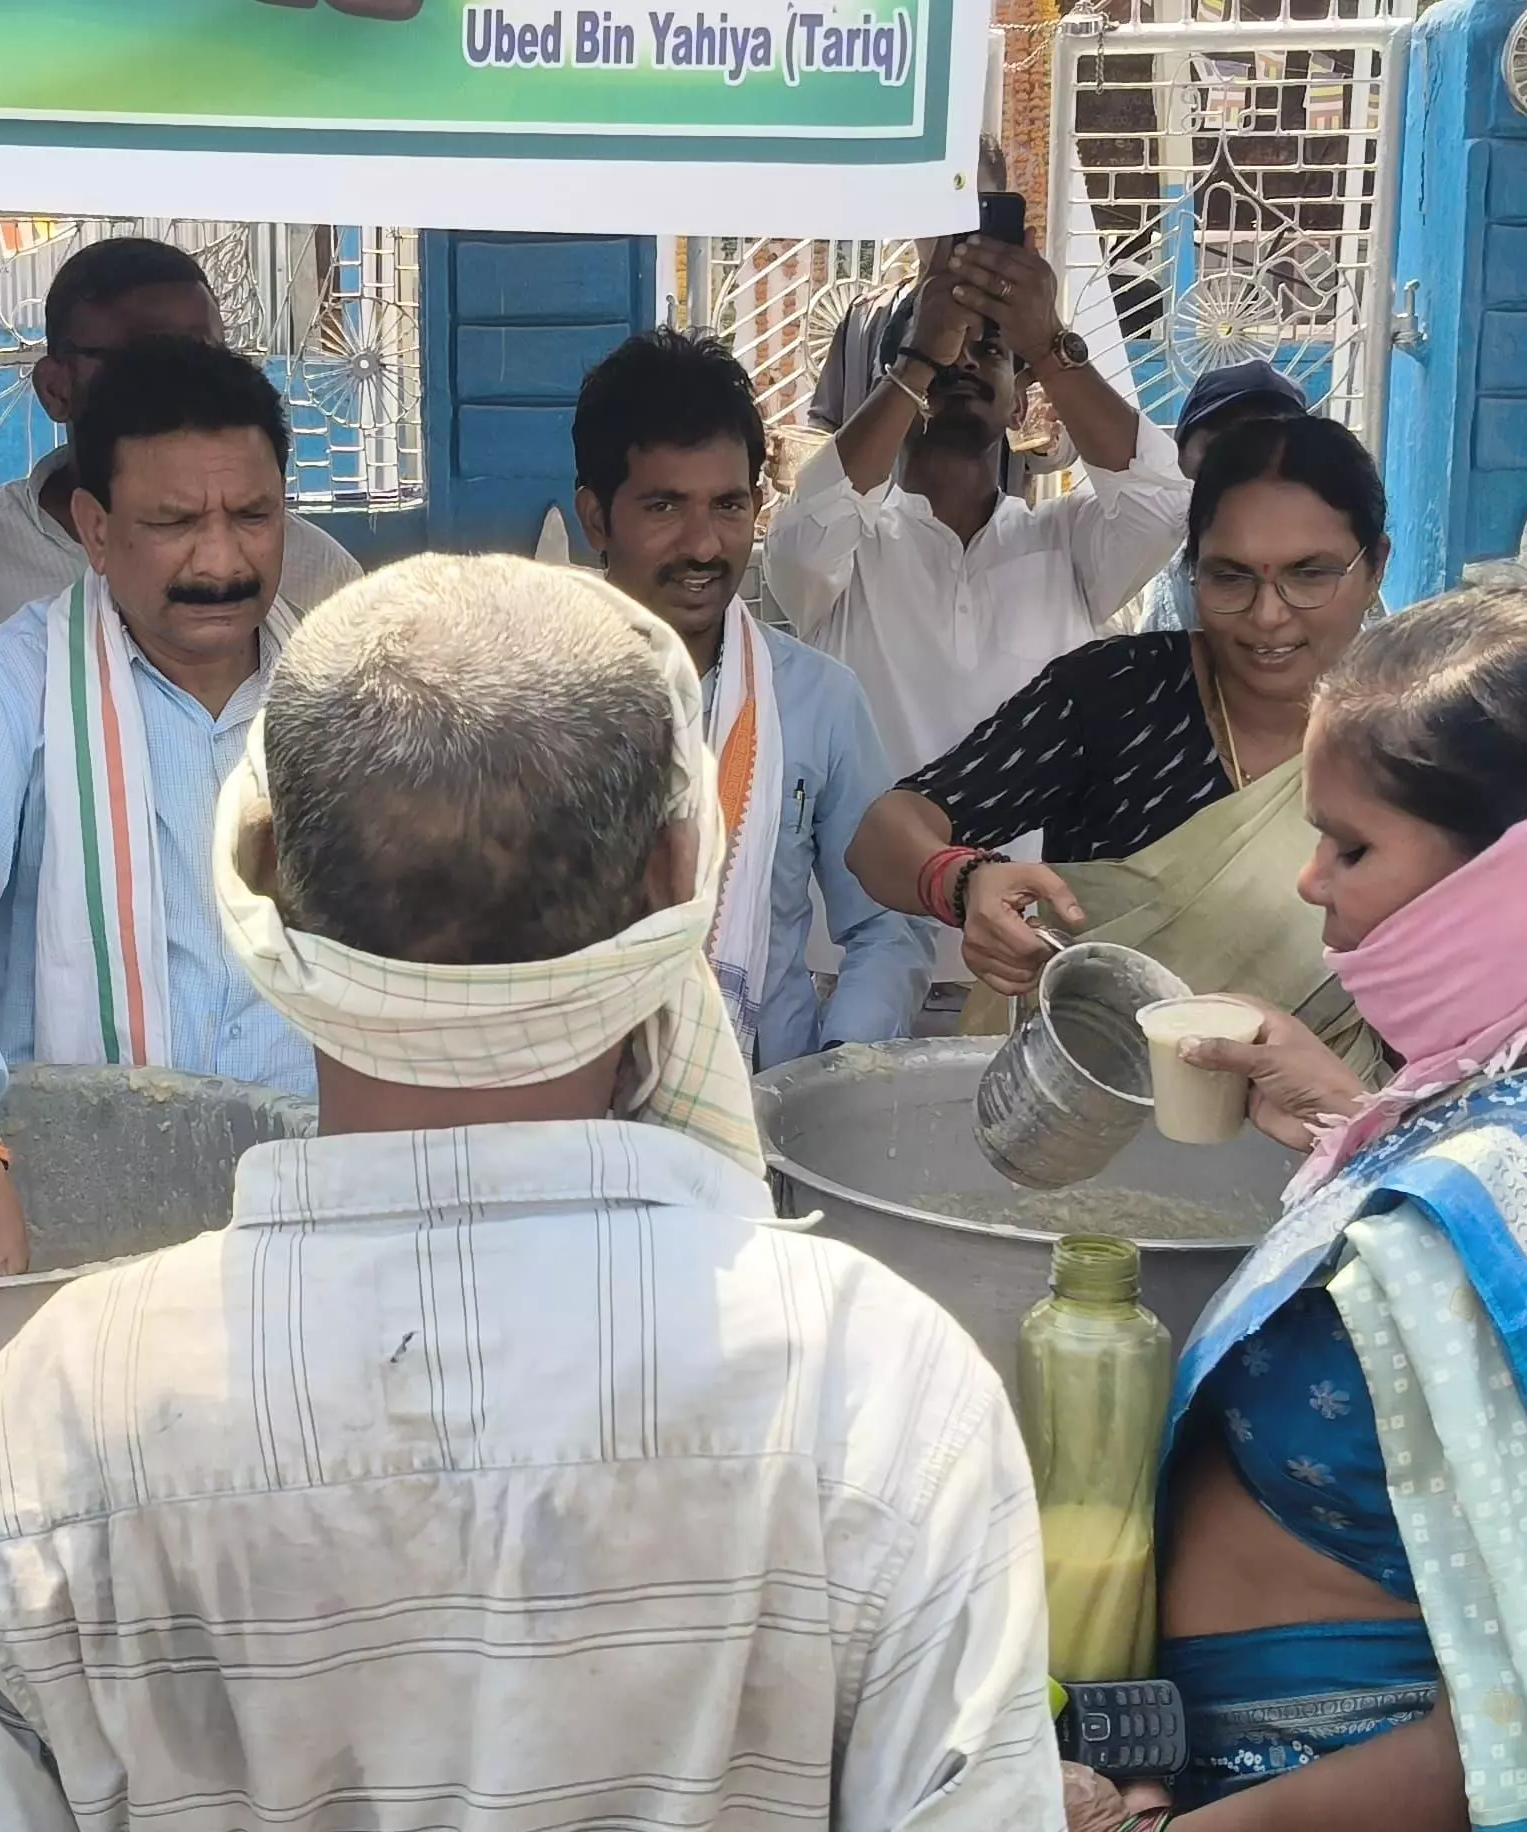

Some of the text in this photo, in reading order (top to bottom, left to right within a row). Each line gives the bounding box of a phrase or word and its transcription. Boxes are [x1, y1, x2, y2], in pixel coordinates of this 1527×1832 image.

[466, 8, 908, 82] Ubed Bin Yahiya (Tariq)
